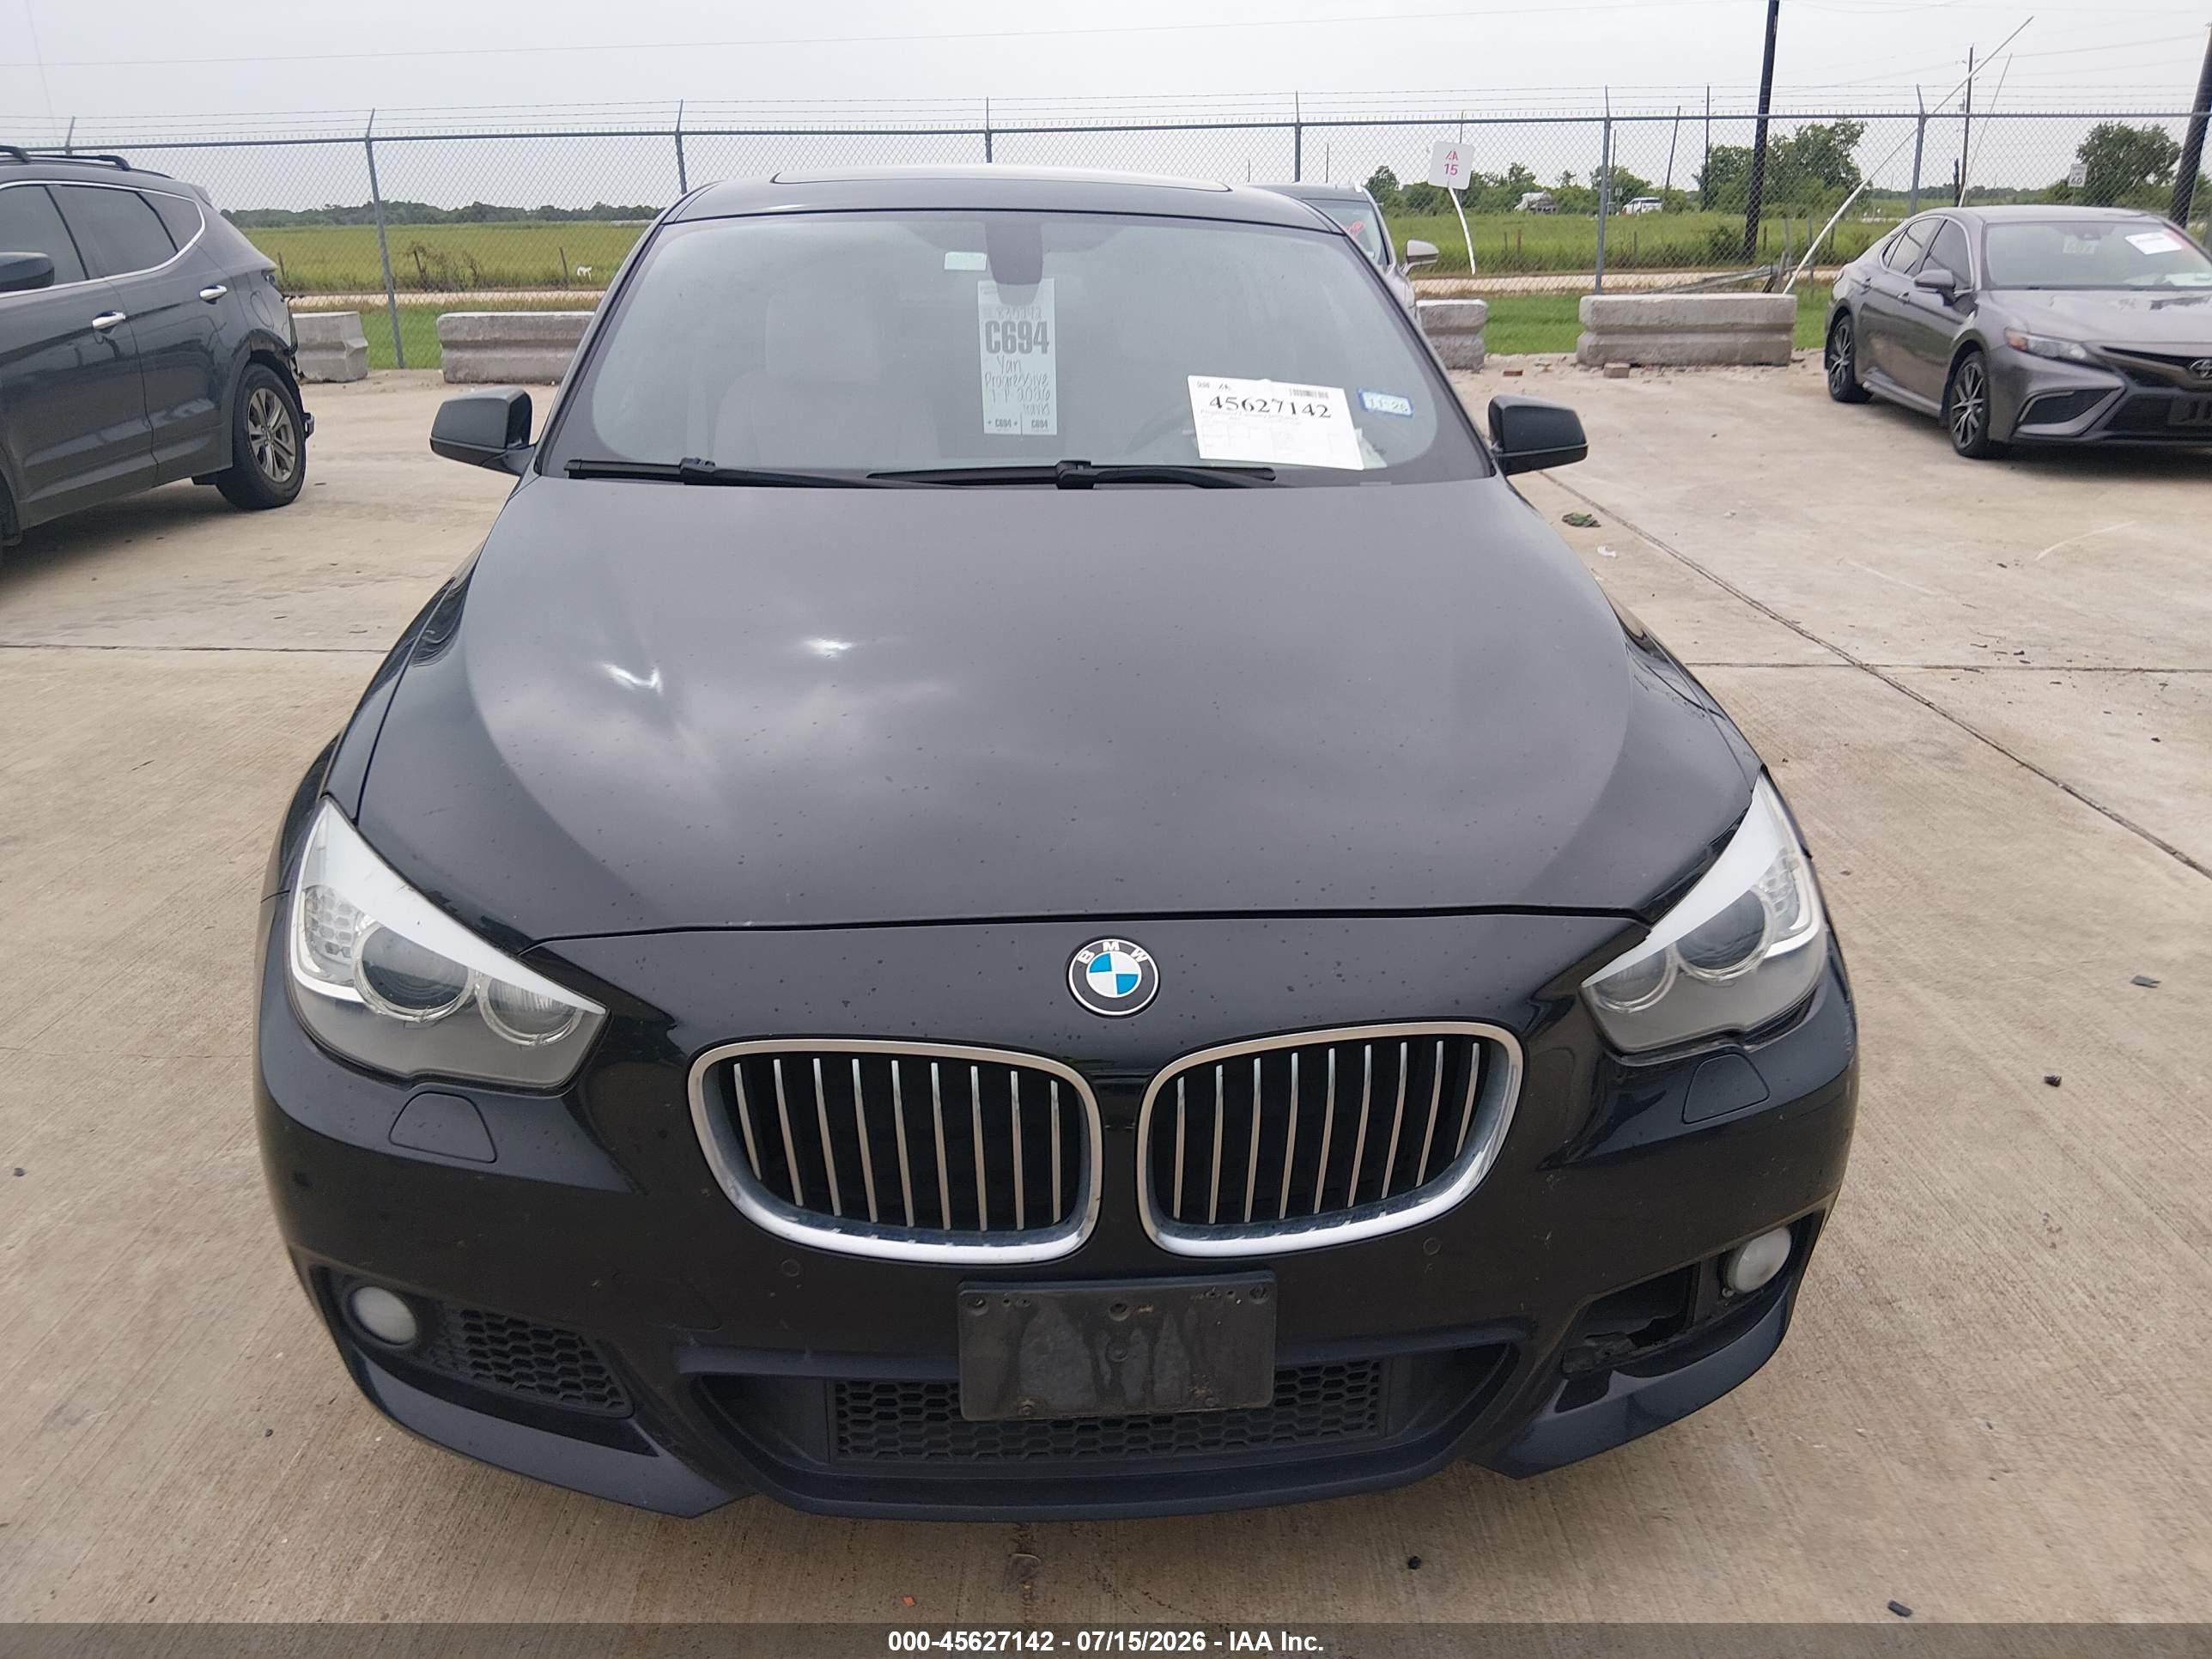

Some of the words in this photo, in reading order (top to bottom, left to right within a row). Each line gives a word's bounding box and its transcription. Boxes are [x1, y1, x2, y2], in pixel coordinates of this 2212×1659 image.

[1443, 163, 1458, 175] 15
[985, 320, 1049, 355] C694
[1209, 395, 1331, 418] 45627142
[1077, 942, 1148, 963] BMW
